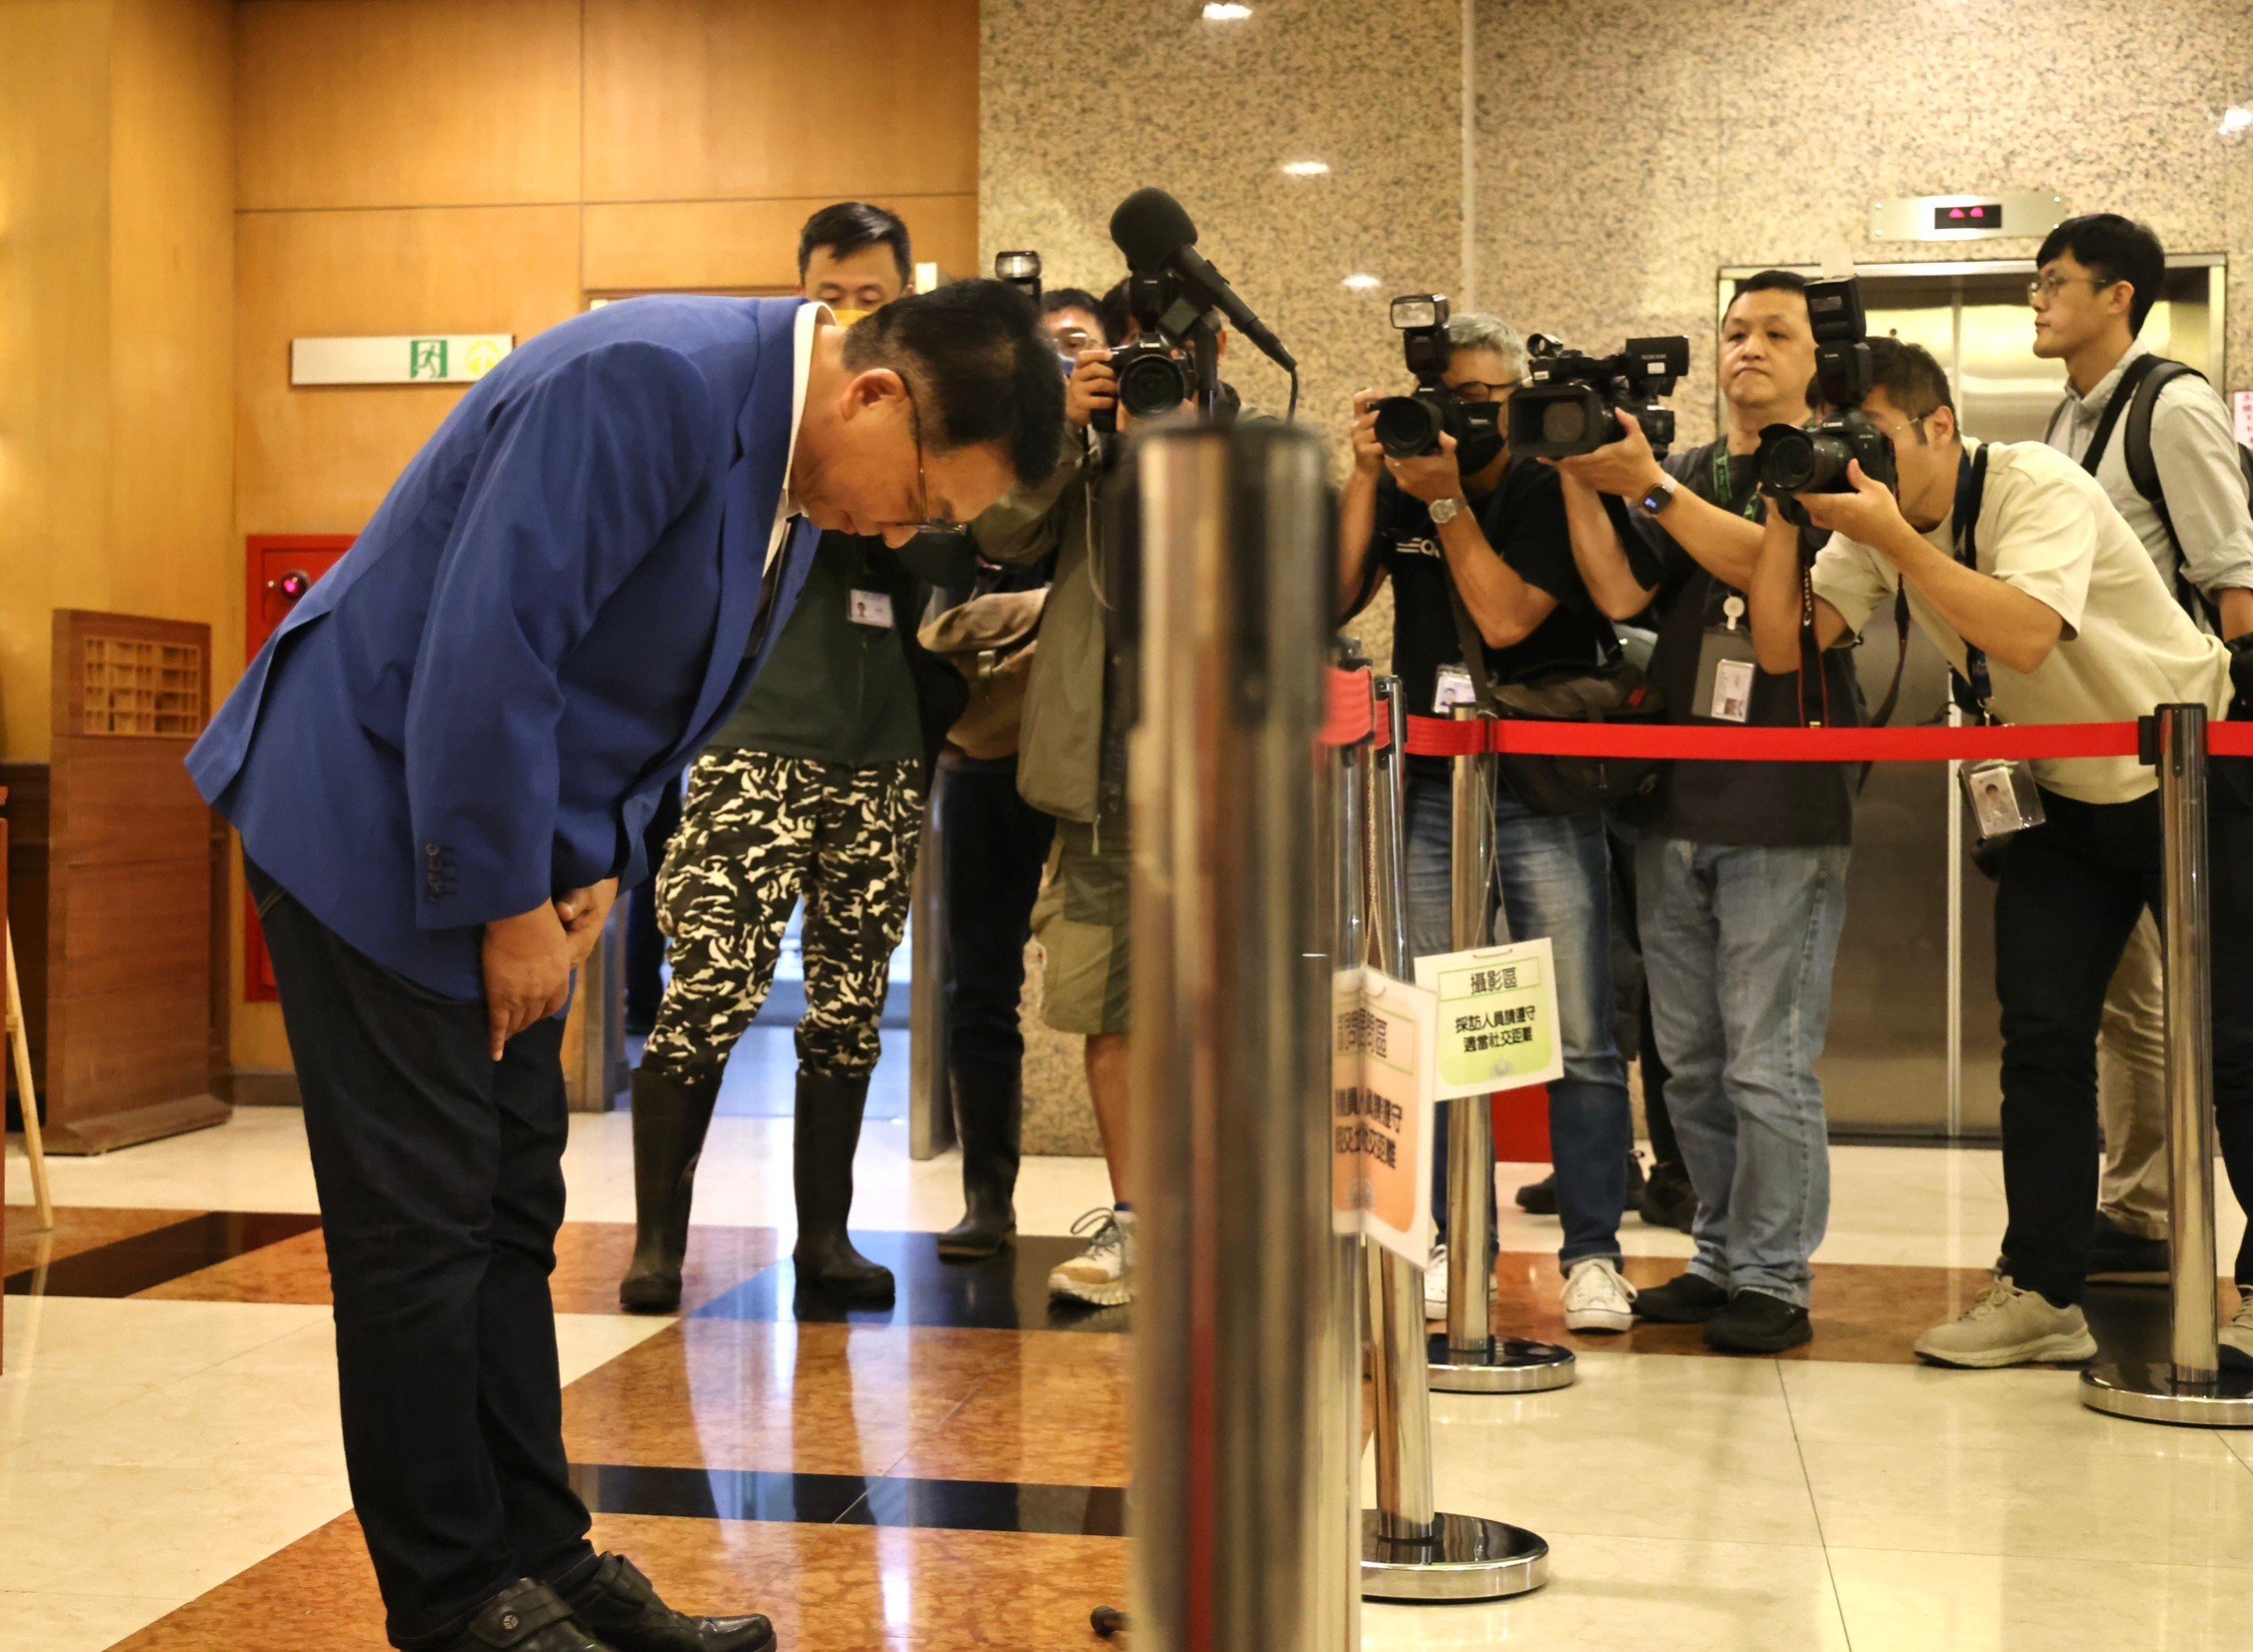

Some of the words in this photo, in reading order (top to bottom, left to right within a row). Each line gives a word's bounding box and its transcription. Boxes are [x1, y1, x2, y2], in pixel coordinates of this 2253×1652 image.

[1471, 967, 1517, 994] 攝影區
[1455, 1006, 1535, 1033] 採訪人員請遵守
[1463, 1026, 1533, 1053] 適當社交距離
